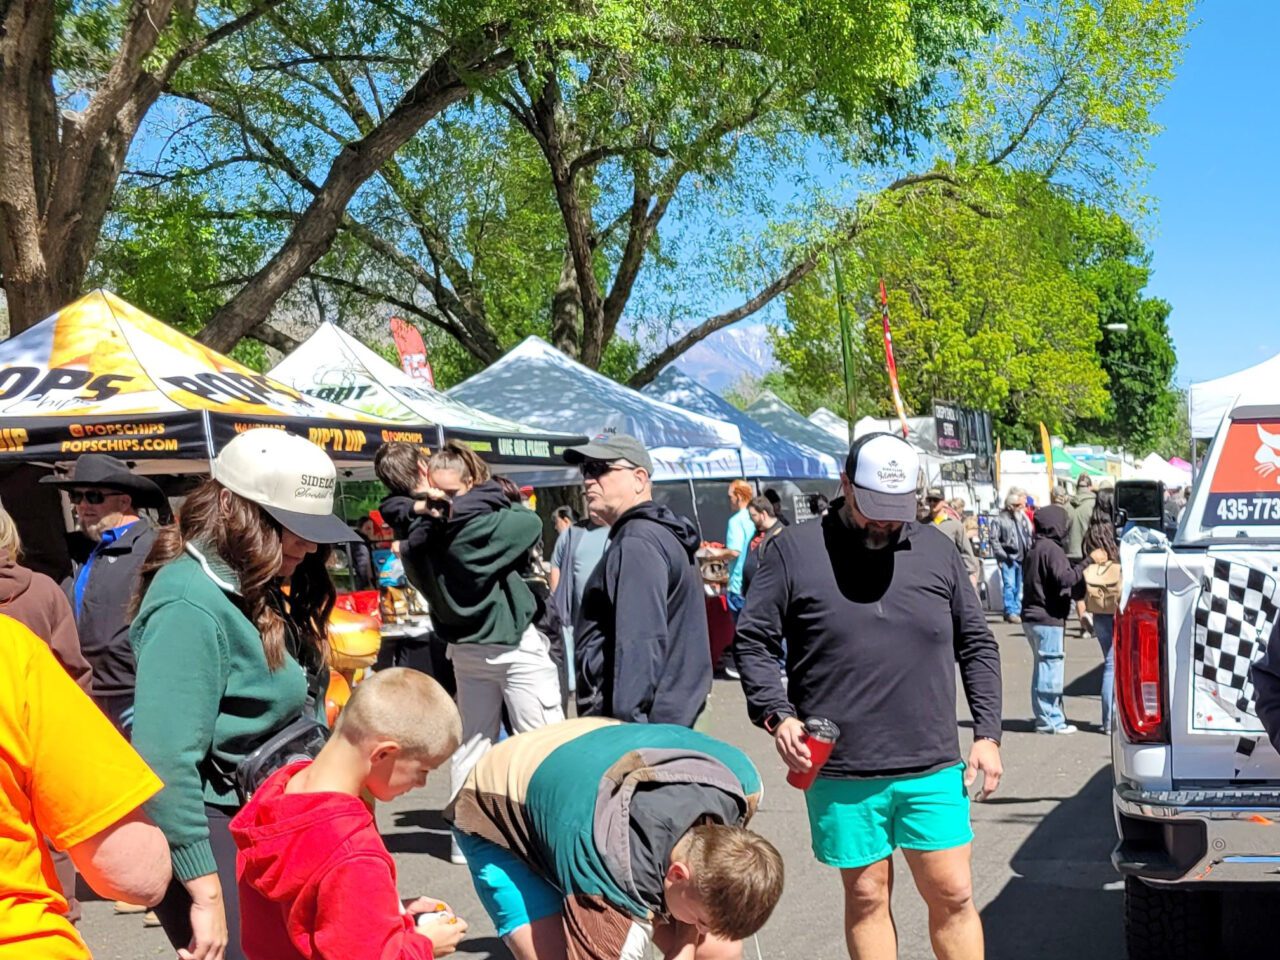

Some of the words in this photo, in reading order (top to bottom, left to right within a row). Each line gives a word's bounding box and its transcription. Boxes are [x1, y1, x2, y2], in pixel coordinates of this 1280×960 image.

[85, 423, 165, 436] POPSCHIPS
[61, 439, 178, 452] POPSCHIPS.COM
[344, 429, 367, 451] DIP
